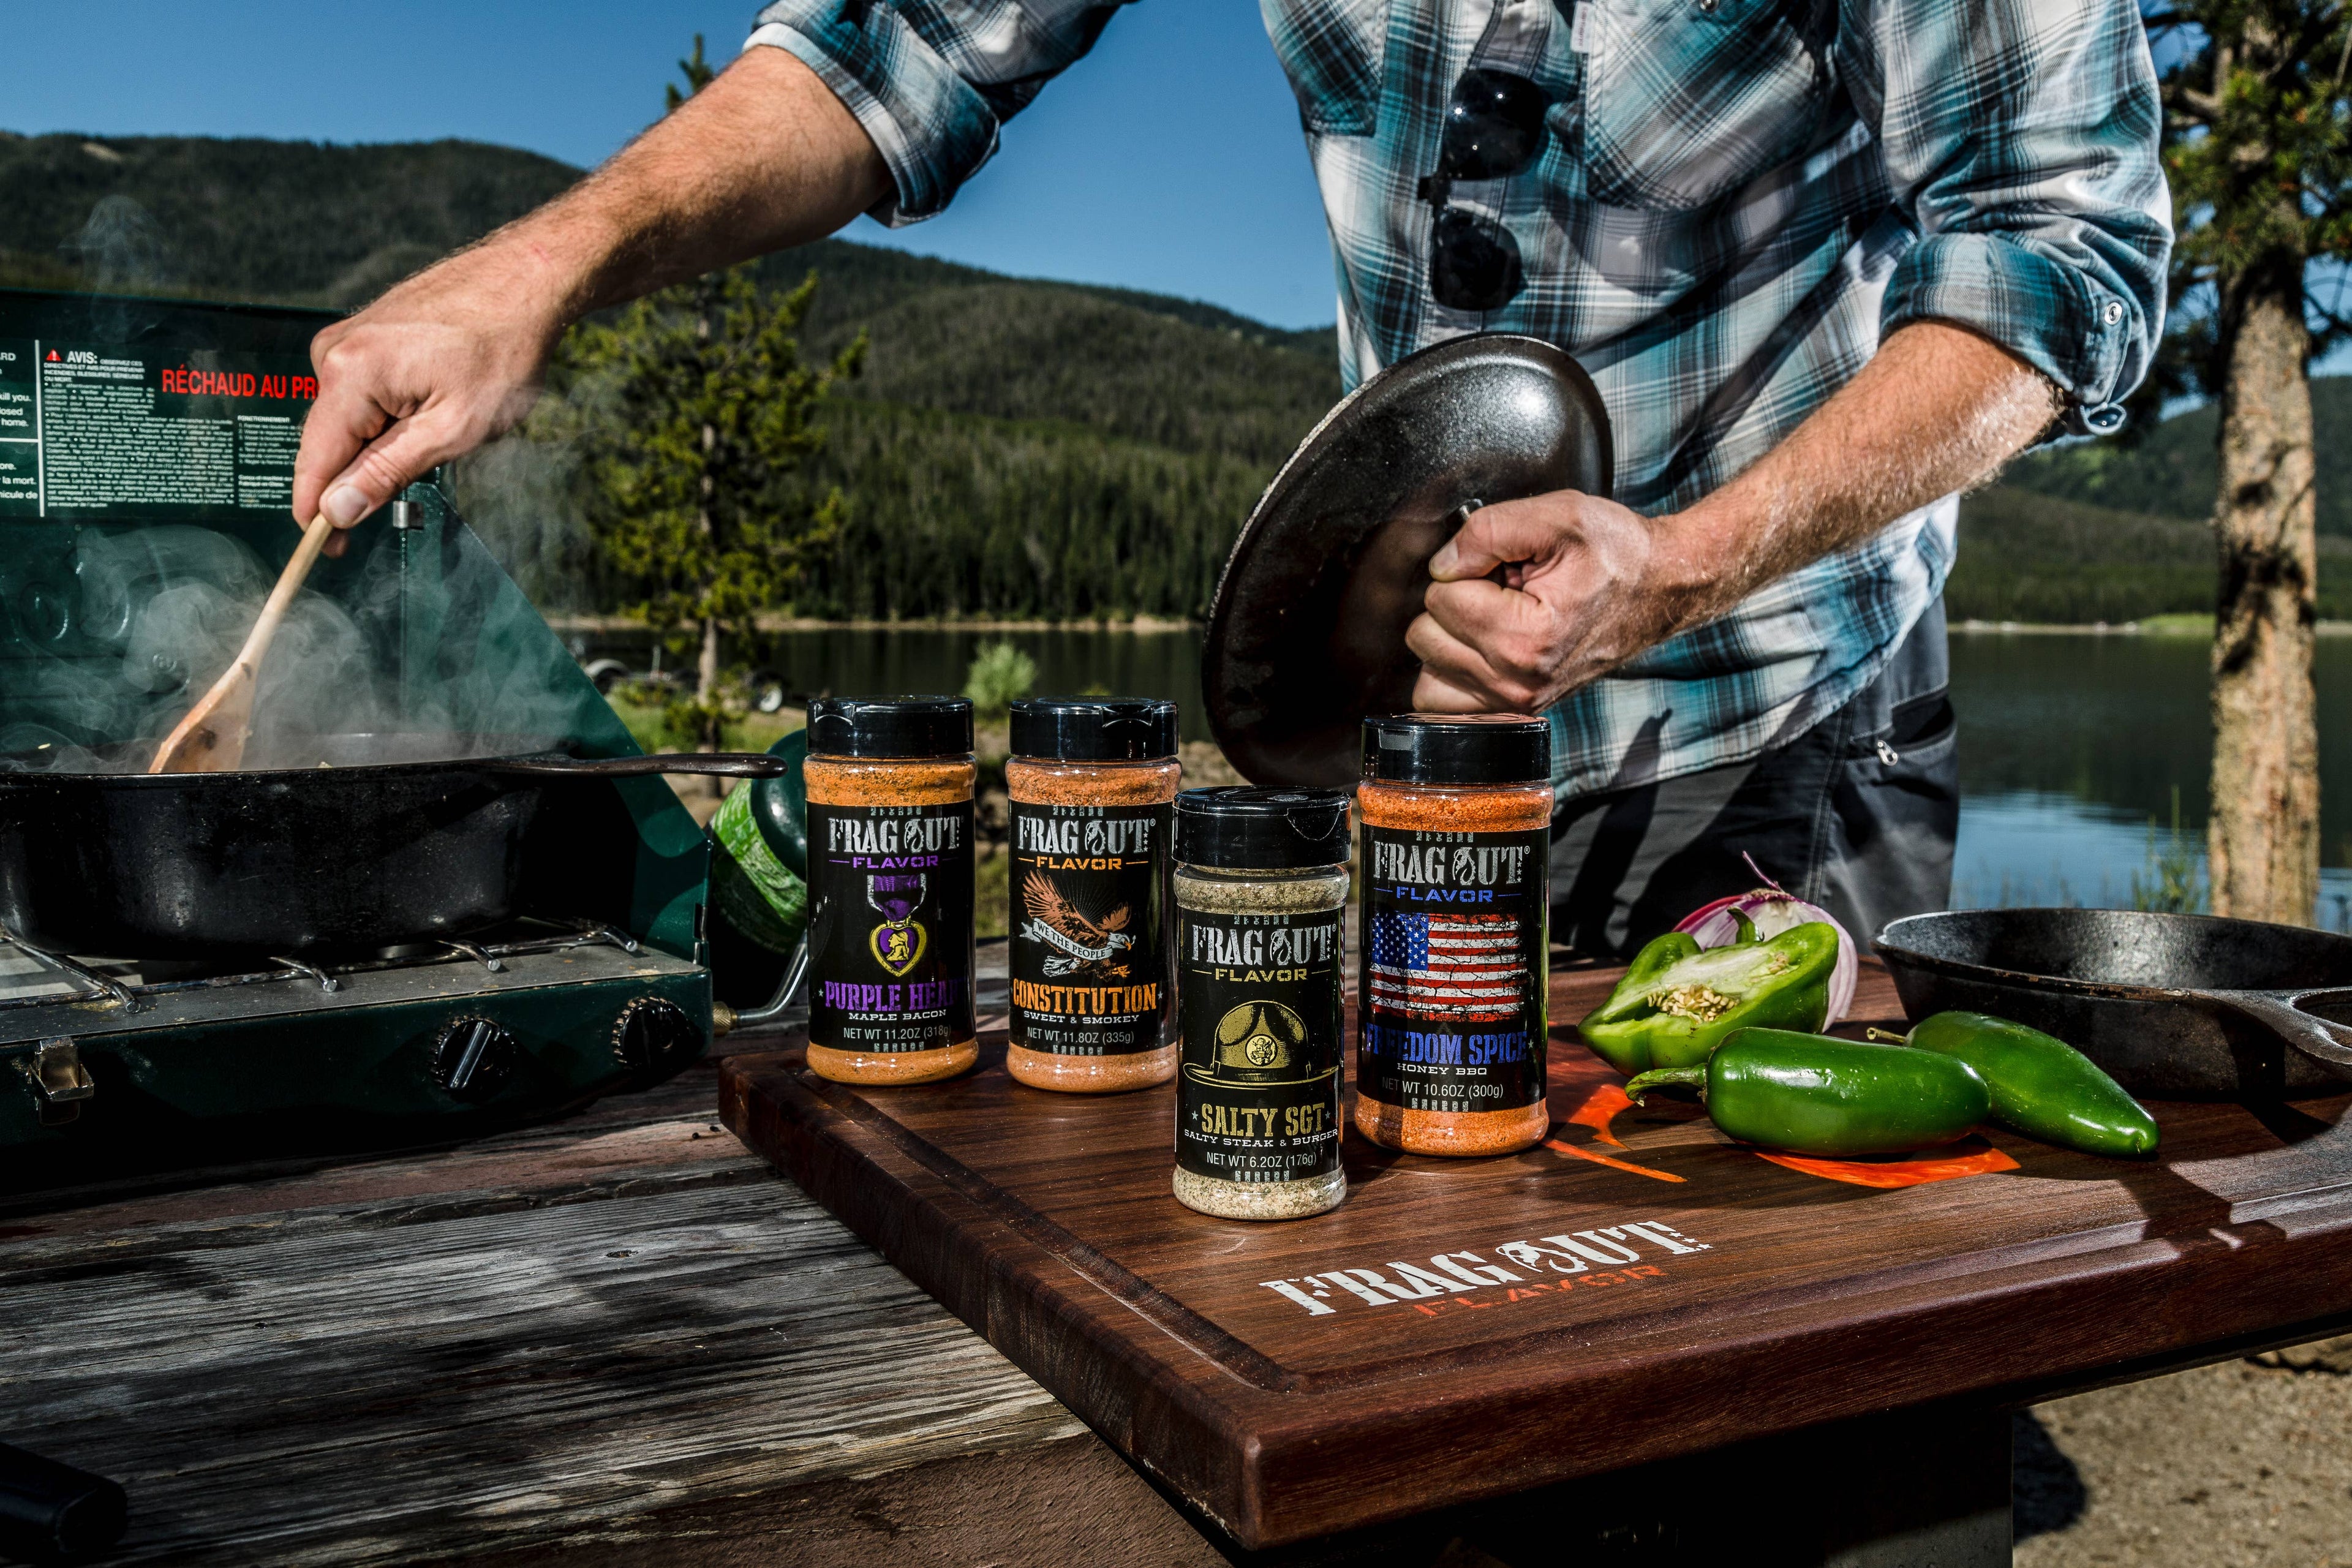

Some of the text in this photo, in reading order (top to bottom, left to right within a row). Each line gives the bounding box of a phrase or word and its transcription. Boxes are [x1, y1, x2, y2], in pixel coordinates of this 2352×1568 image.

[0, 352, 16, 361] RD
[67, 351, 97, 364] AVIS:
[162, 364, 319, 399] RÉCHAUD AU PR
[12, 393, 31, 402] you.
[1, 418, 29, 427] home.
[828, 817, 899, 854] FRAG
[1018, 815, 1079, 854] FRAG
[853, 855, 939, 869] FLAVOR
[1036, 856, 1122, 870] FLAVOR
[1373, 840, 1446, 885] FRAG
[1396, 886, 1493, 903] FLAVOR
[1038, 922, 1106, 959] WE THE PEOPLE
[1192, 924, 1262, 966] FRAG
[1215, 968, 1307, 982] FLAVOR
[825, 981, 901, 1011] PURPLE
[1013, 978, 1157, 1015] CONSTITUTION
[849, 1009, 946, 1021] MAPLE BACON
[1023, 1011, 1065, 1023] SWEET
[1082, 1015, 1139, 1024] SMOKEY
[843, 1025, 951, 1040] NET WT 11.2OZ (318g)
[1027, 1027, 1134, 1046] NET WT 11.8OZ (335g)
[1469, 1031, 1528, 1065] SPICE
[1397, 1063, 1449, 1075] HONEY
[1382, 1076, 1503, 1099] NET WT 10.6OZ (300g)
[1201, 1102, 1325, 1137] SALTY SGT
[1184, 1129, 1218, 1144] SALTY
[1223, 1138, 1274, 1147] STEAK
[1292, 1129, 1338, 1145] BURGER
[1207, 1152, 1316, 1169] NET WT 6.2OZ (176g)
[1259, 1250, 1525, 1316] FRAG
[1413, 1265, 1668, 1316] FLAVOR
